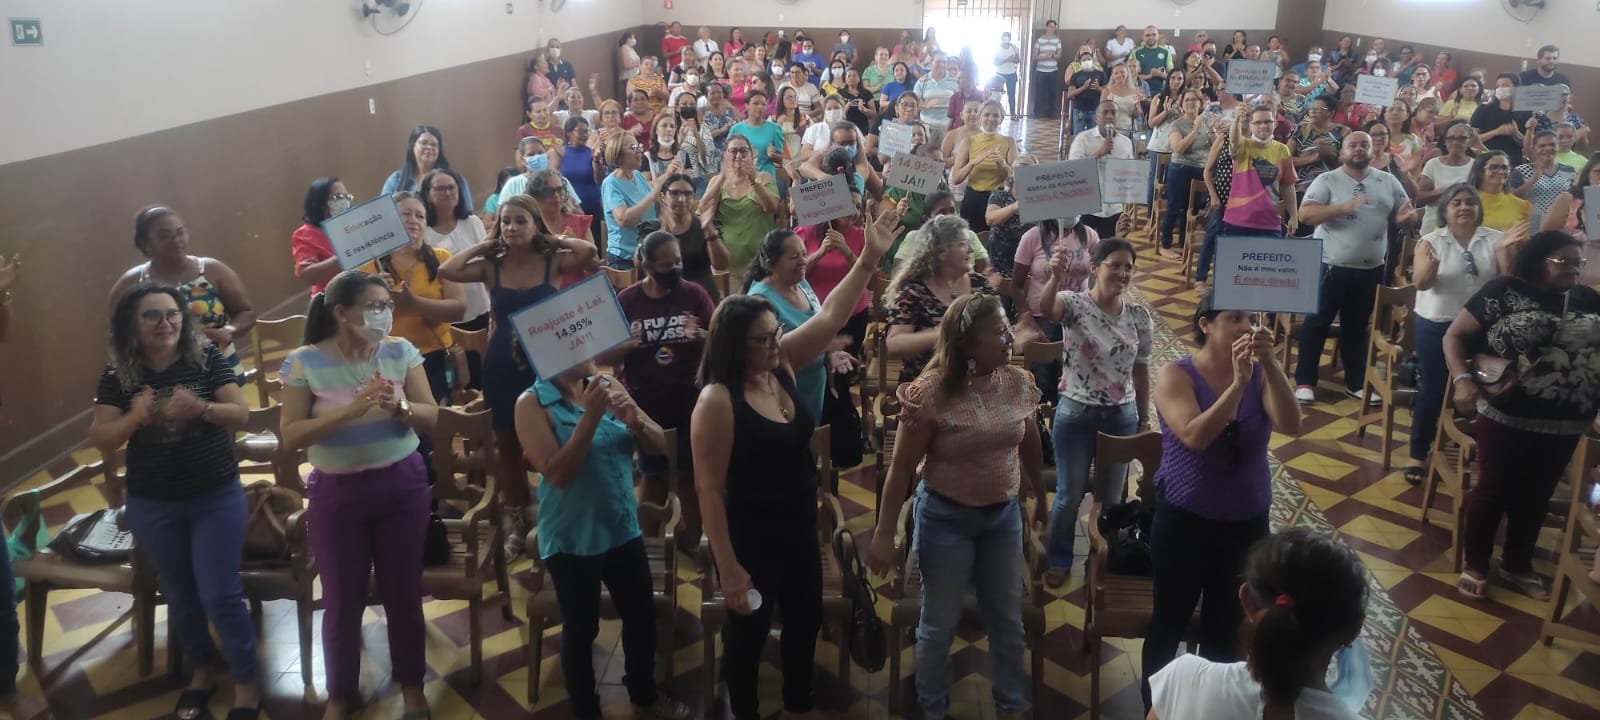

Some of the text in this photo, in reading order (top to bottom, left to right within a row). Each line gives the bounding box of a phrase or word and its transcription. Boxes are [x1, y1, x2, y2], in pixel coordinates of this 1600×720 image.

[800, 180, 833, 194] PREFEITO
[344, 213, 383, 234] Educação
[1242, 252, 1295, 263] PREFEITO,
[528, 309, 576, 337] Reajuste
[555, 316, 593, 341] 14,95%
